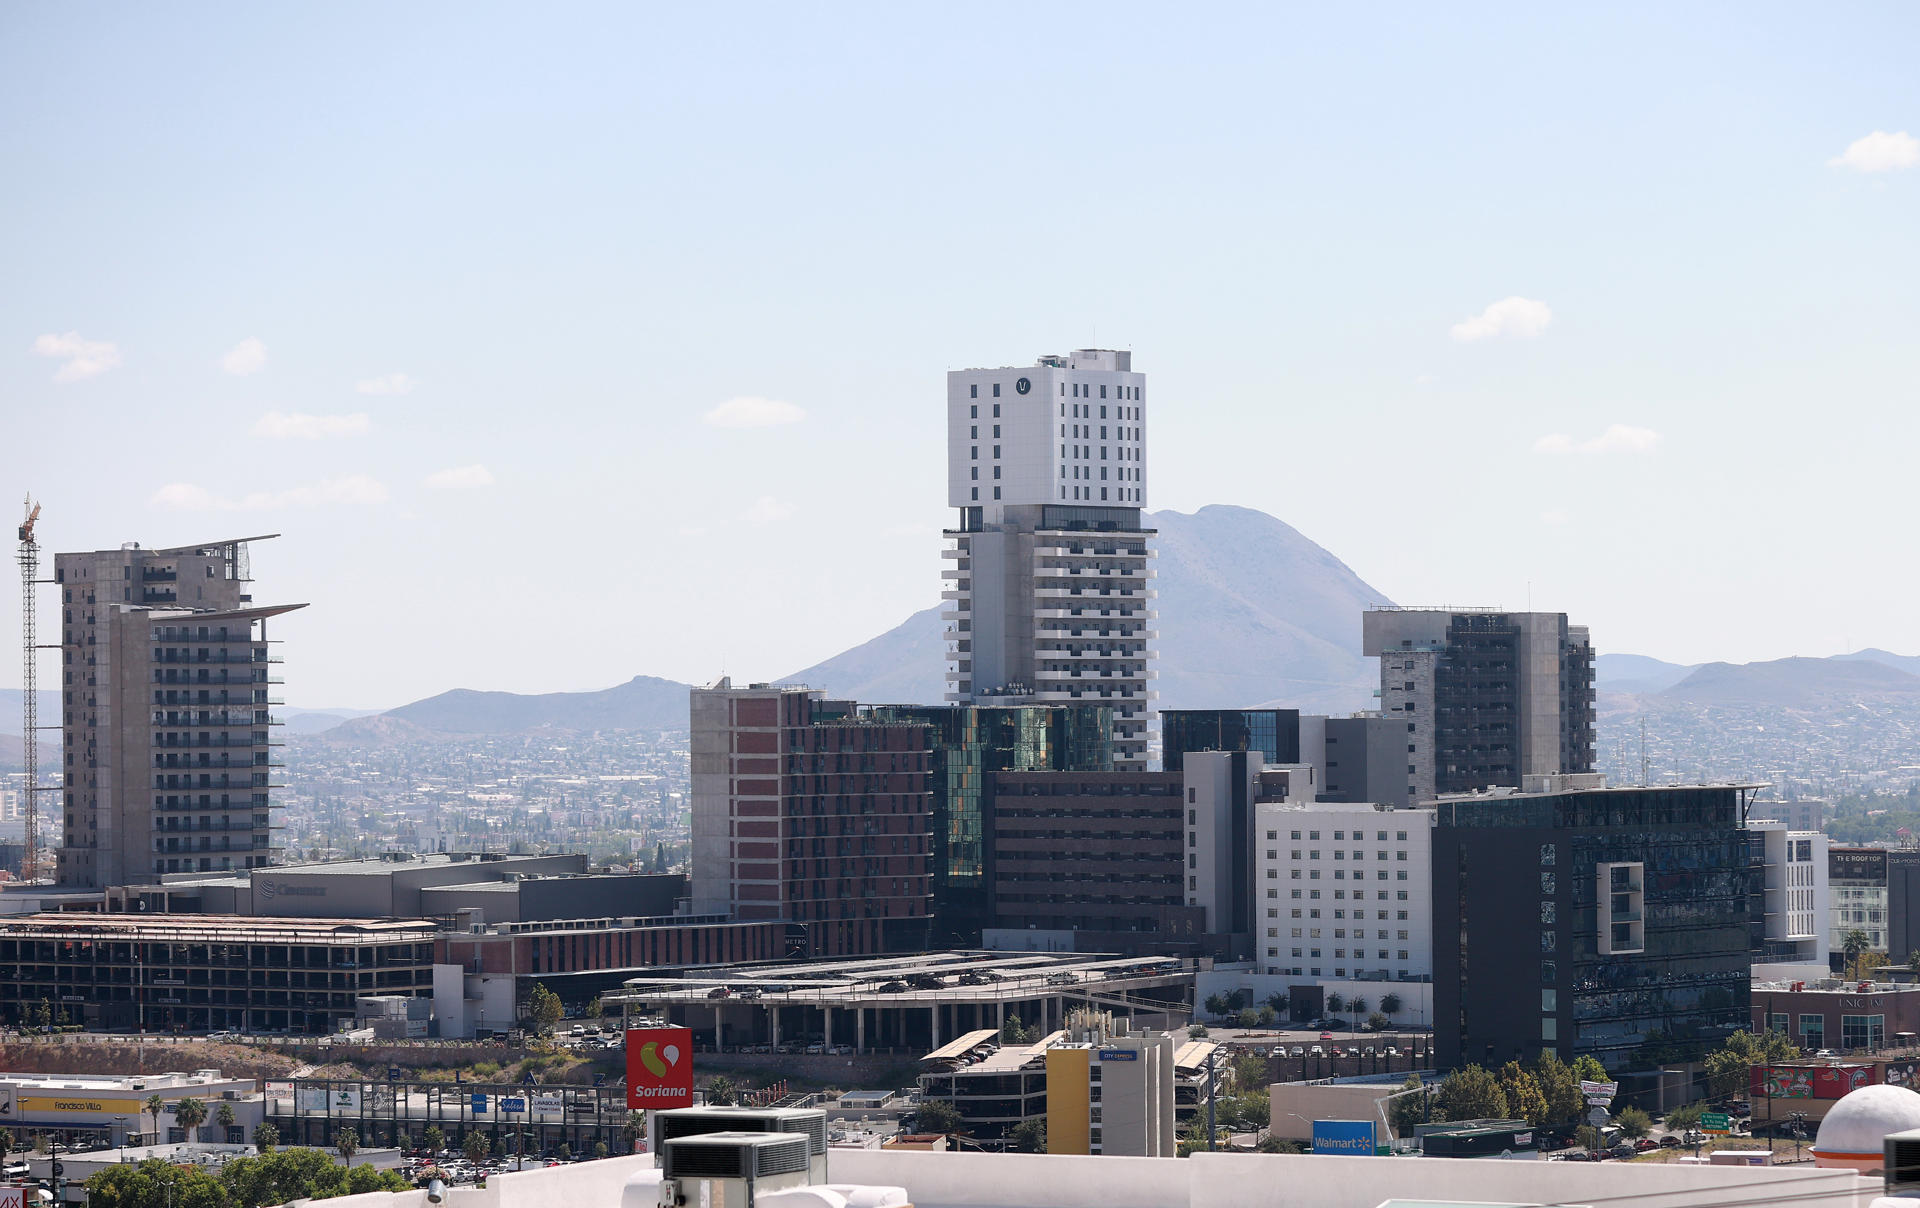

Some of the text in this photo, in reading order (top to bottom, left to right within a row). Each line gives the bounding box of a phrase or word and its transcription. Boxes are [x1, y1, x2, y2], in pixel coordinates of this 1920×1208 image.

[635, 1084, 687, 1097] Soriana
[55, 1102, 102, 1110] Francisco Villa
[1315, 1137, 1357, 1149] Walmart
